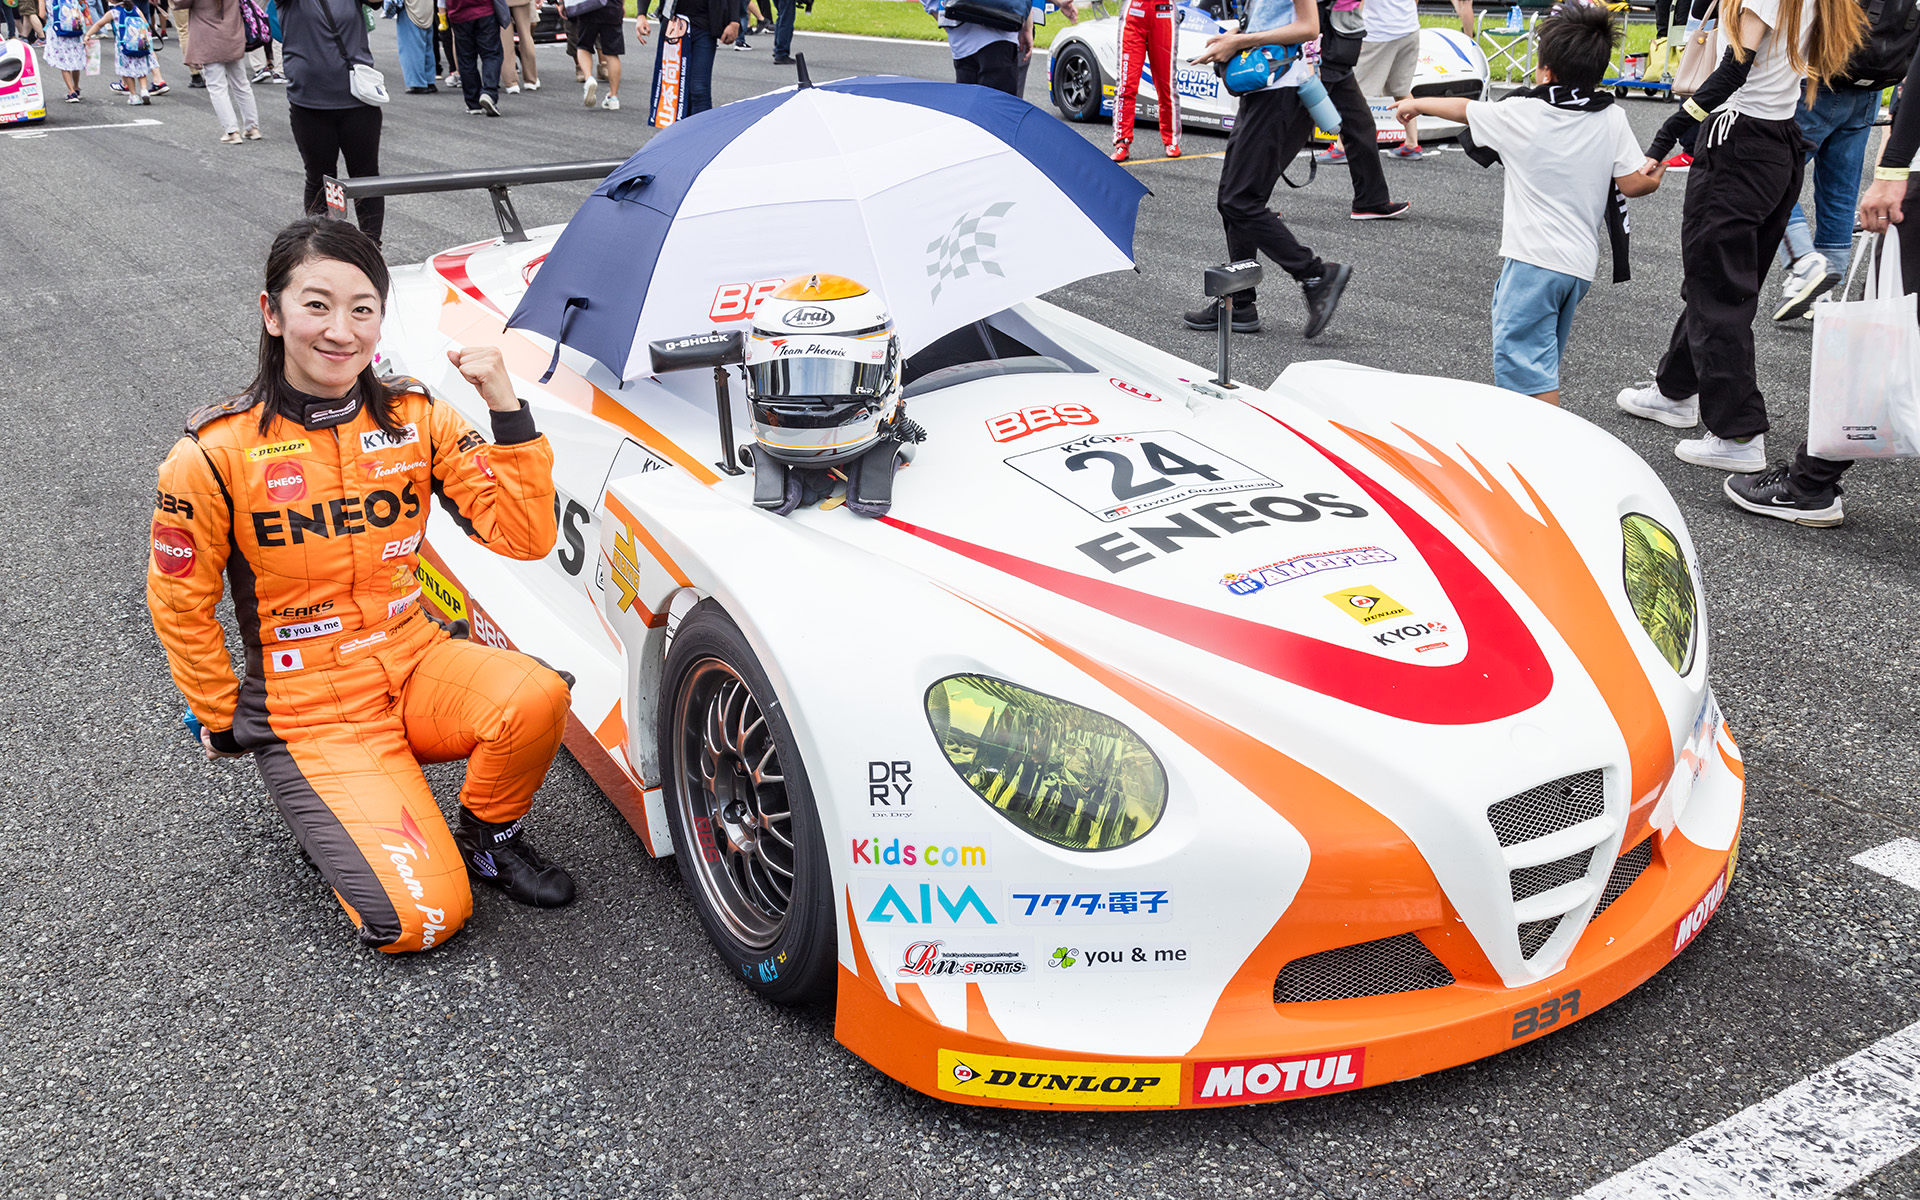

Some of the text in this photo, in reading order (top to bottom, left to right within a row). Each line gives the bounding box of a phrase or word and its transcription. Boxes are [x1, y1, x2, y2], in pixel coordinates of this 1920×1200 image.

[1177, 70, 1217, 85] GURA
[709, 278, 785, 323] BB
[789, 308, 830, 323] Arai
[665, 333, 729, 351] G-SHOCK
[778, 343, 847, 357] Team Phoenix
[985, 403, 1099, 442] BBS
[258, 442, 305, 457] DUNLOP
[267, 474, 303, 488] ENEOS
[1065, 442, 1225, 501] 24
[252, 480, 421, 547] ENEOS
[1075, 492, 1369, 574] ENEOS
[154, 539, 193, 558] ENEOS
[417, 566, 461, 614] UNLOP
[271, 599, 334, 617] LEARS
[1363, 608, 1405, 623] DUNLOP
[293, 621, 339, 637] you & me
[693, 816, 720, 863] BBS
[852, 837, 986, 867] Kids com
[381, 842, 425, 900] Team
[866, 883, 998, 924] AIM
[1012, 890, 1169, 916] フクダ電子
[1674, 872, 1725, 951] MOTUL
[1084, 947, 1187, 966] you & me
[984, 1069, 1161, 1093] DUNLOP
[1200, 1054, 1357, 1098] MOTUL
